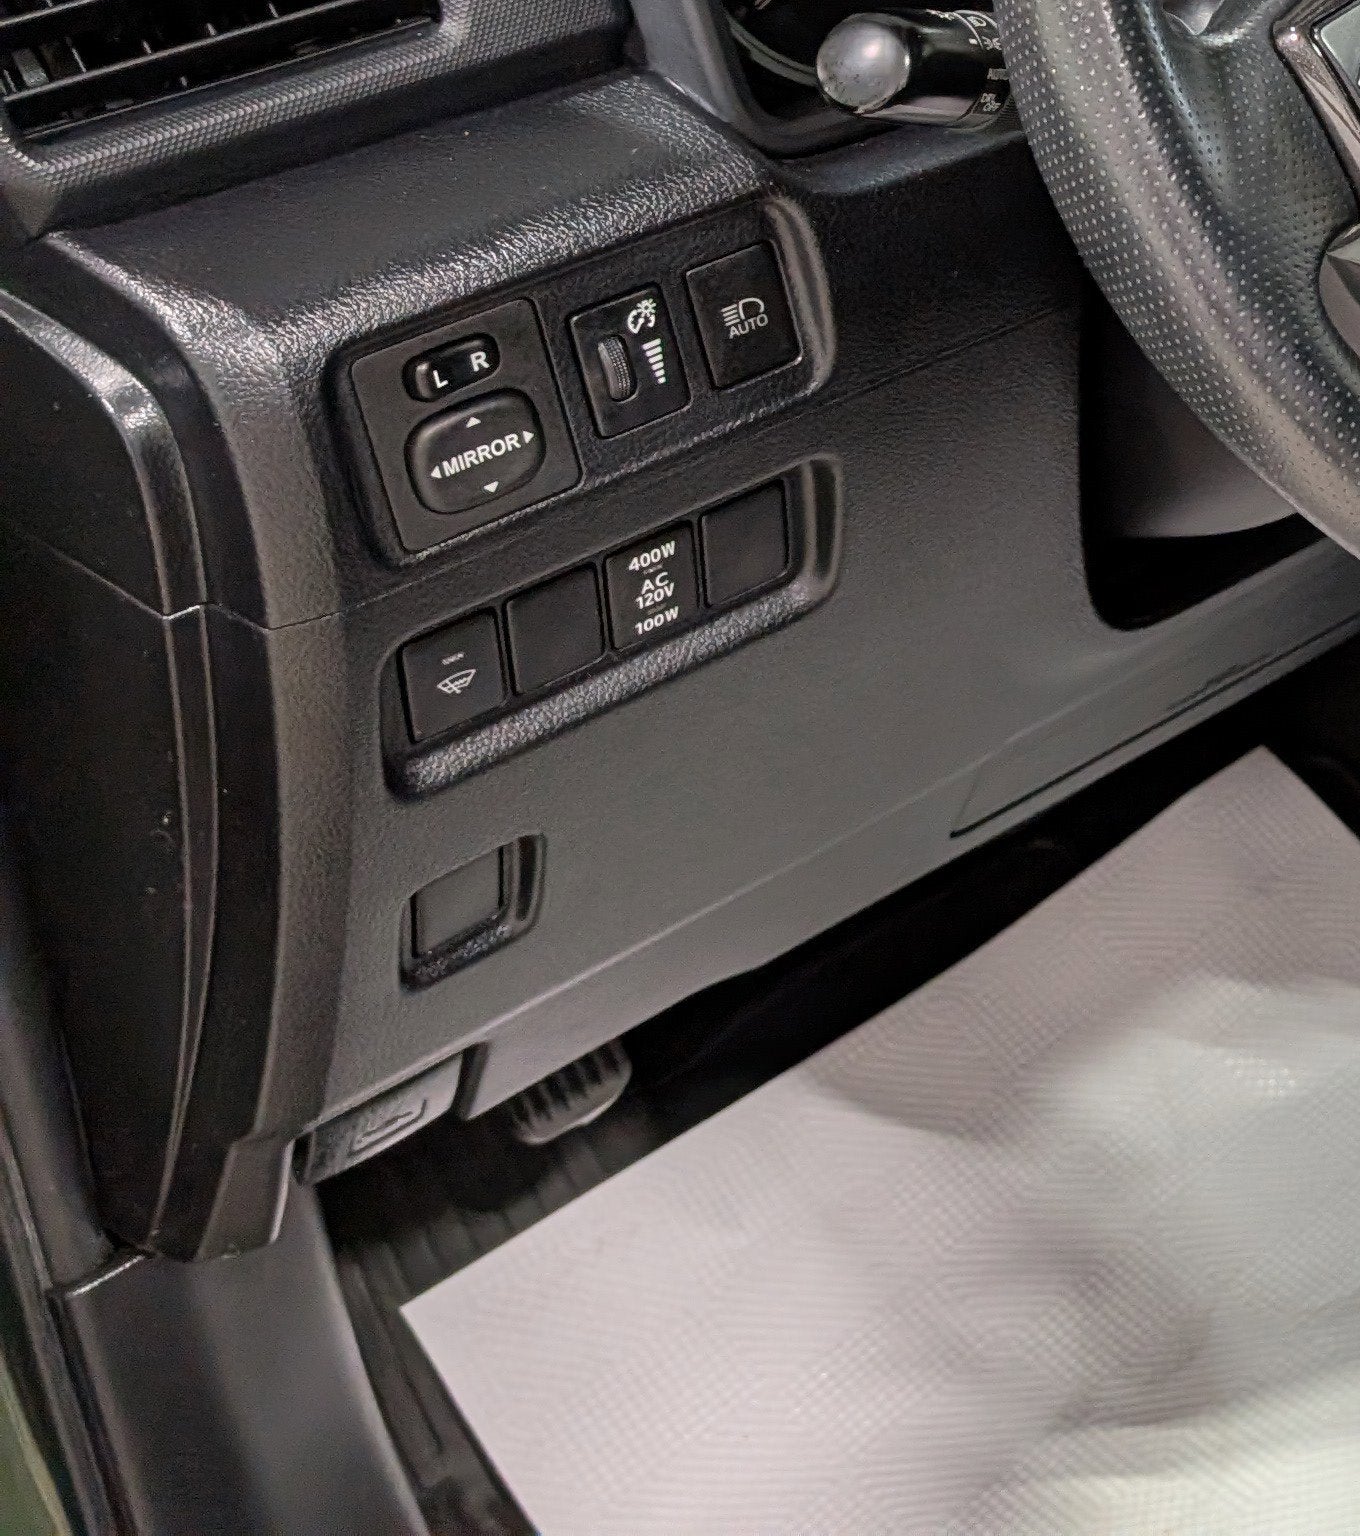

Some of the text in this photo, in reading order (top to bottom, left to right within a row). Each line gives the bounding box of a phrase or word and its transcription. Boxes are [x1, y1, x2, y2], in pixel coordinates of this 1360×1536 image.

[729, 314, 769, 340] AUTO
[433, 351, 490, 389] L R
[441, 433, 522, 477] MIRROR
[628, 540, 676, 572] 400W
[635, 582, 675, 610] 120V
[641, 571, 669, 595] AC
[635, 605, 679, 635] 100W
